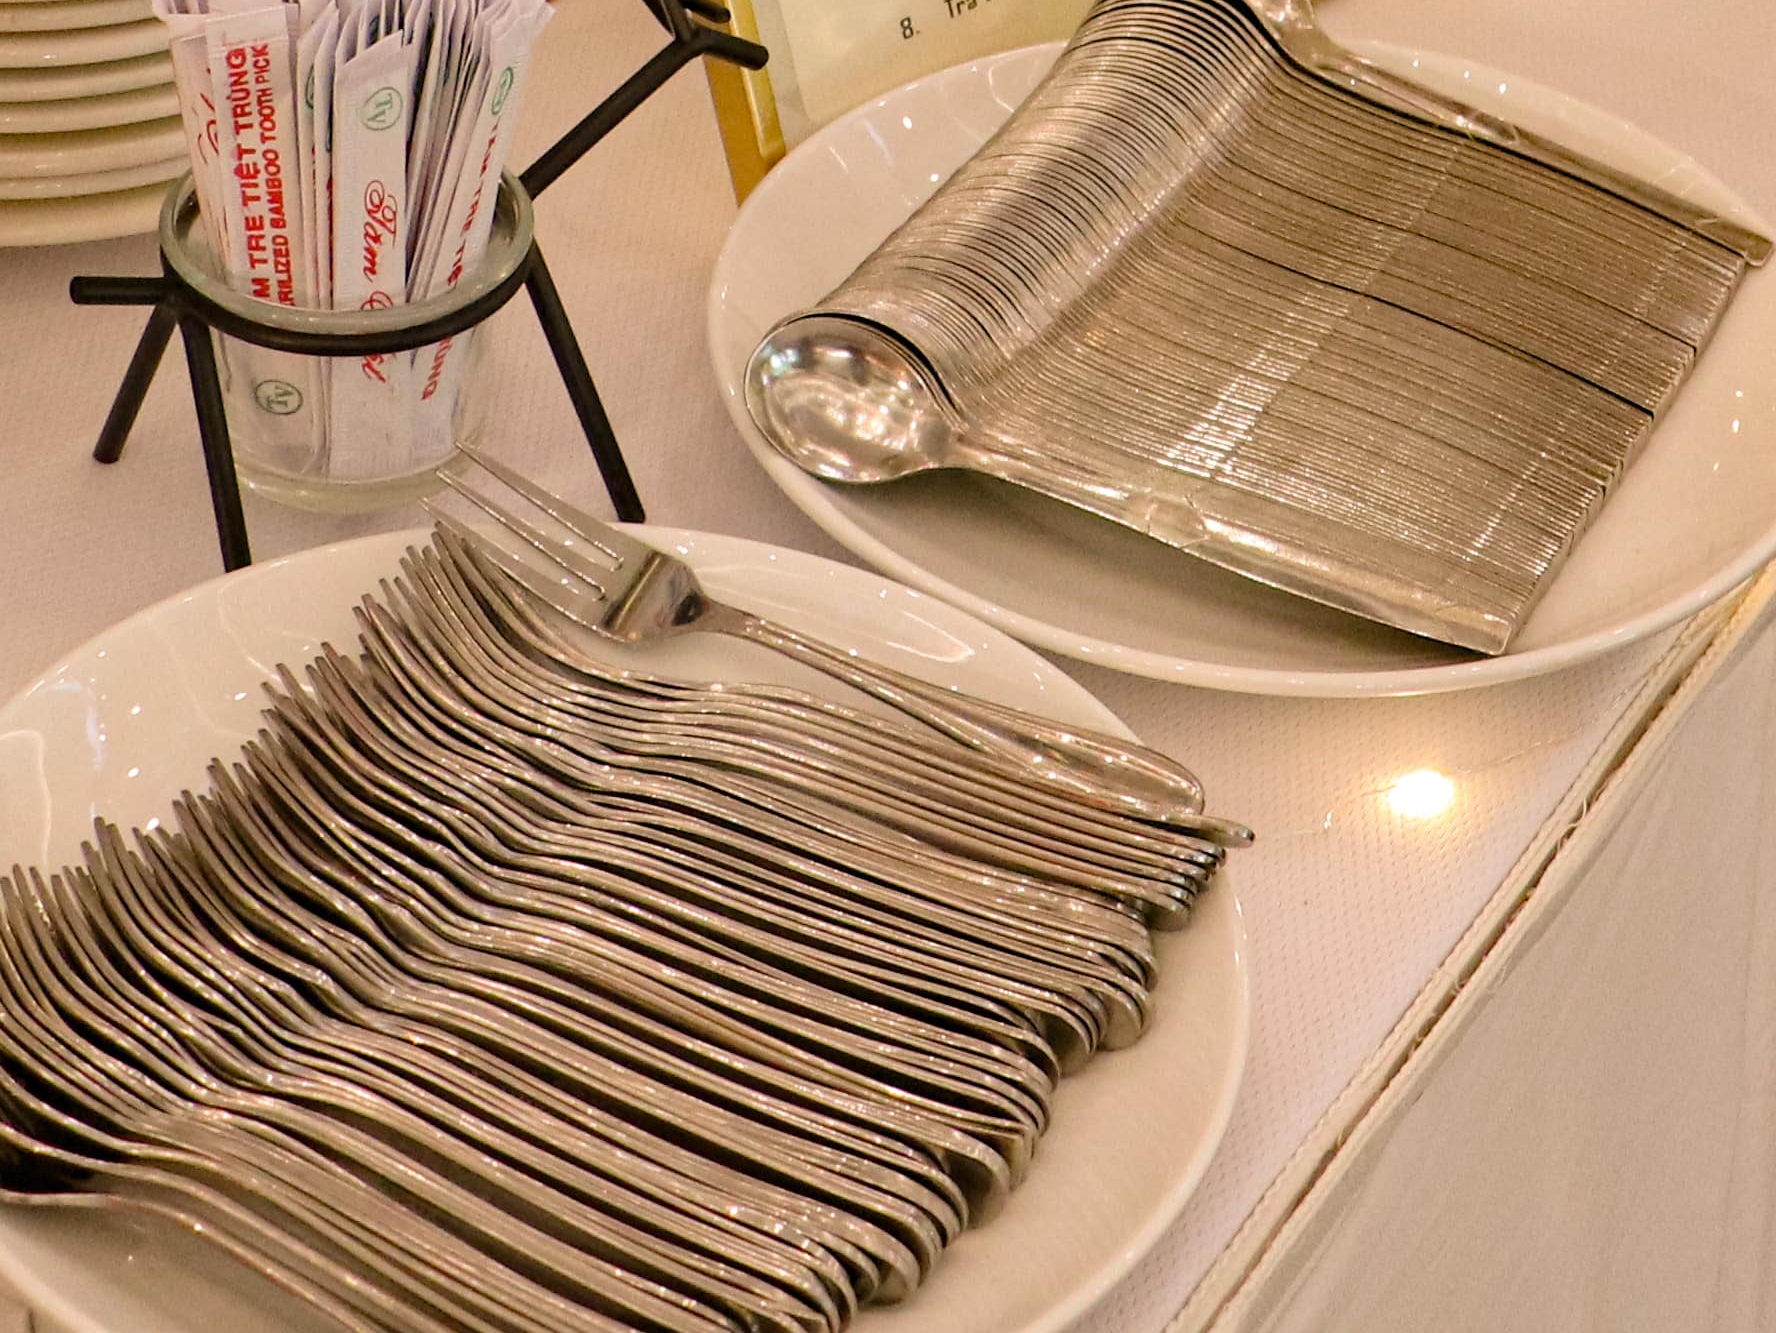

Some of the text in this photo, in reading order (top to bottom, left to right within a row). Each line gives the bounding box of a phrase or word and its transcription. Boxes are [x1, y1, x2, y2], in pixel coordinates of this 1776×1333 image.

[899, 16, 921, 41] 8.
[252, 43, 272, 87] PICK
[255, 90, 279, 146] TOOTH
[261, 148, 287, 231] BAMBOO
[244, 214, 268, 273] TRE
